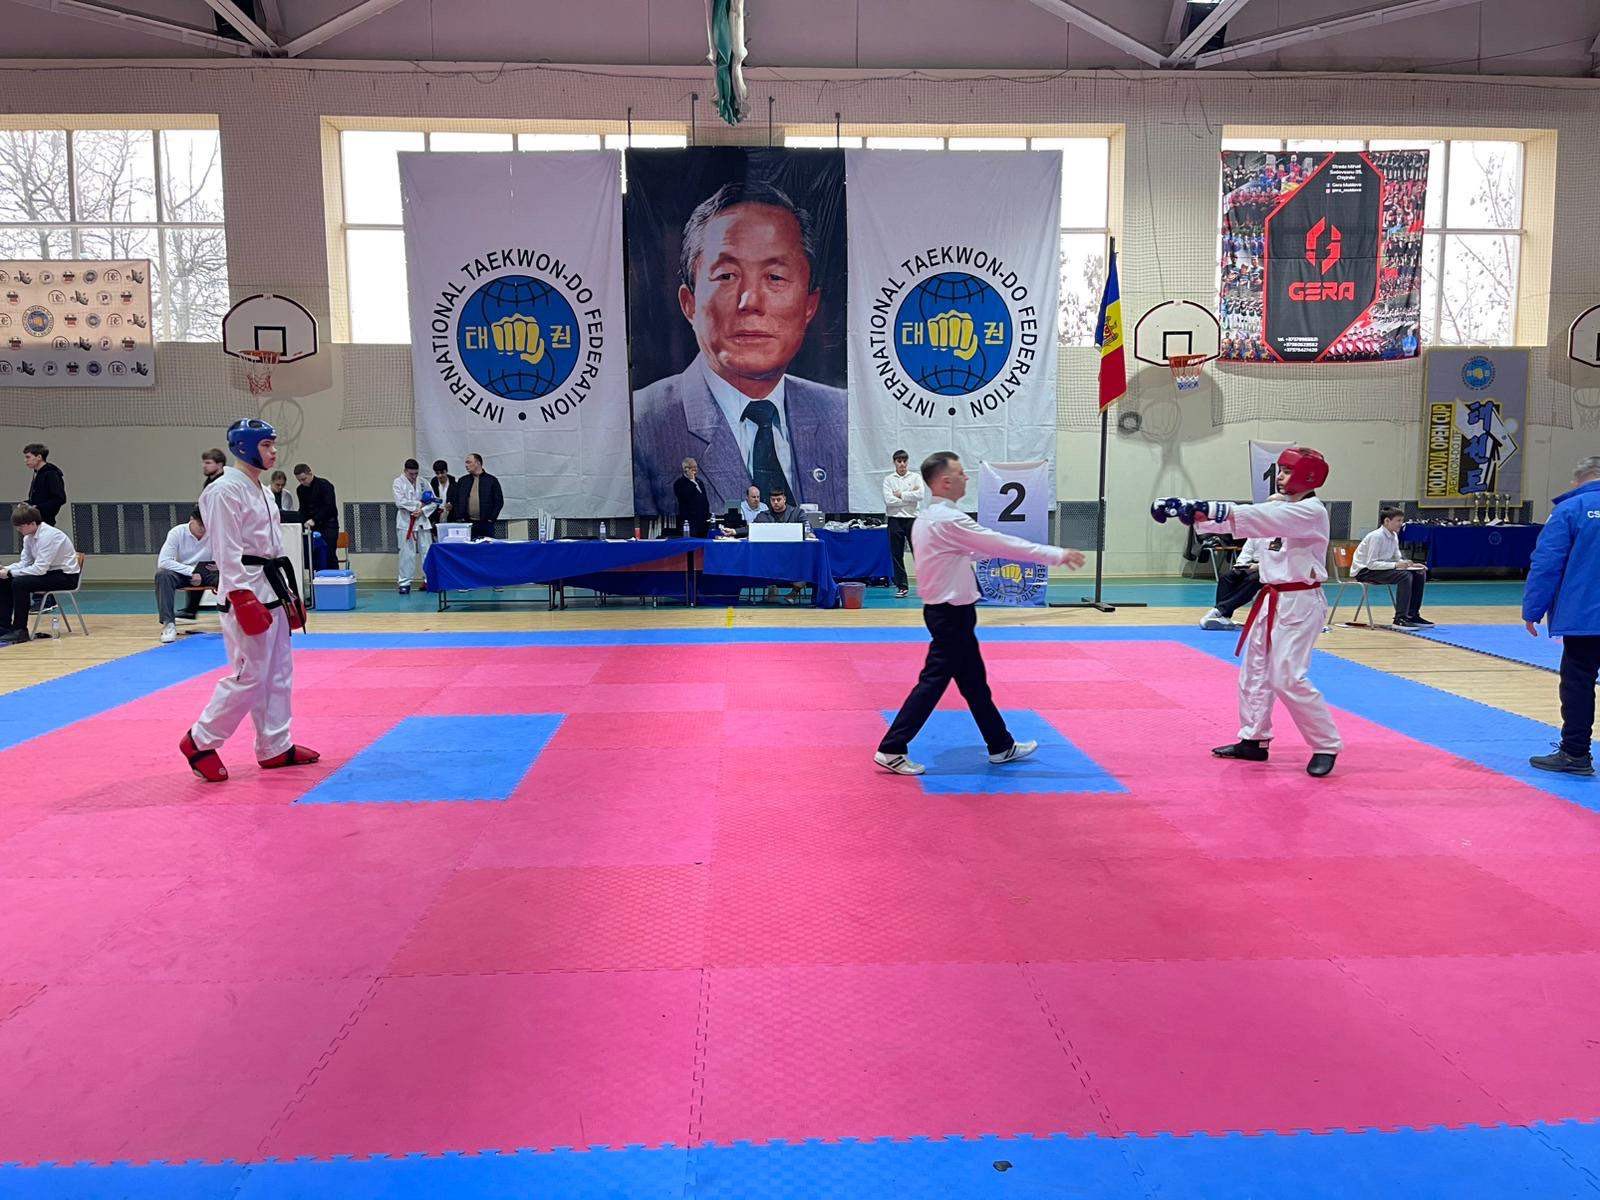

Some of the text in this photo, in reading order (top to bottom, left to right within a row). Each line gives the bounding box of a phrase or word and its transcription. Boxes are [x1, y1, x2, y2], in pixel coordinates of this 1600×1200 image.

[1288, 281, 1355, 301] GERA
[431, 248, 604, 423] INTERNATIONAL TAEKWON-DO FEDERATION
[465, 325, 572, 349] 태 권
[870, 246, 1038, 419] INTERNATIONAL TAEKWON-DO FEDERATION
[902, 322, 1004, 345] 태 권
[1427, 405, 1451, 496] MOLDOVA OPEN CUP
[1263, 463, 1276, 495] 1
[998, 482, 1026, 522] 2
